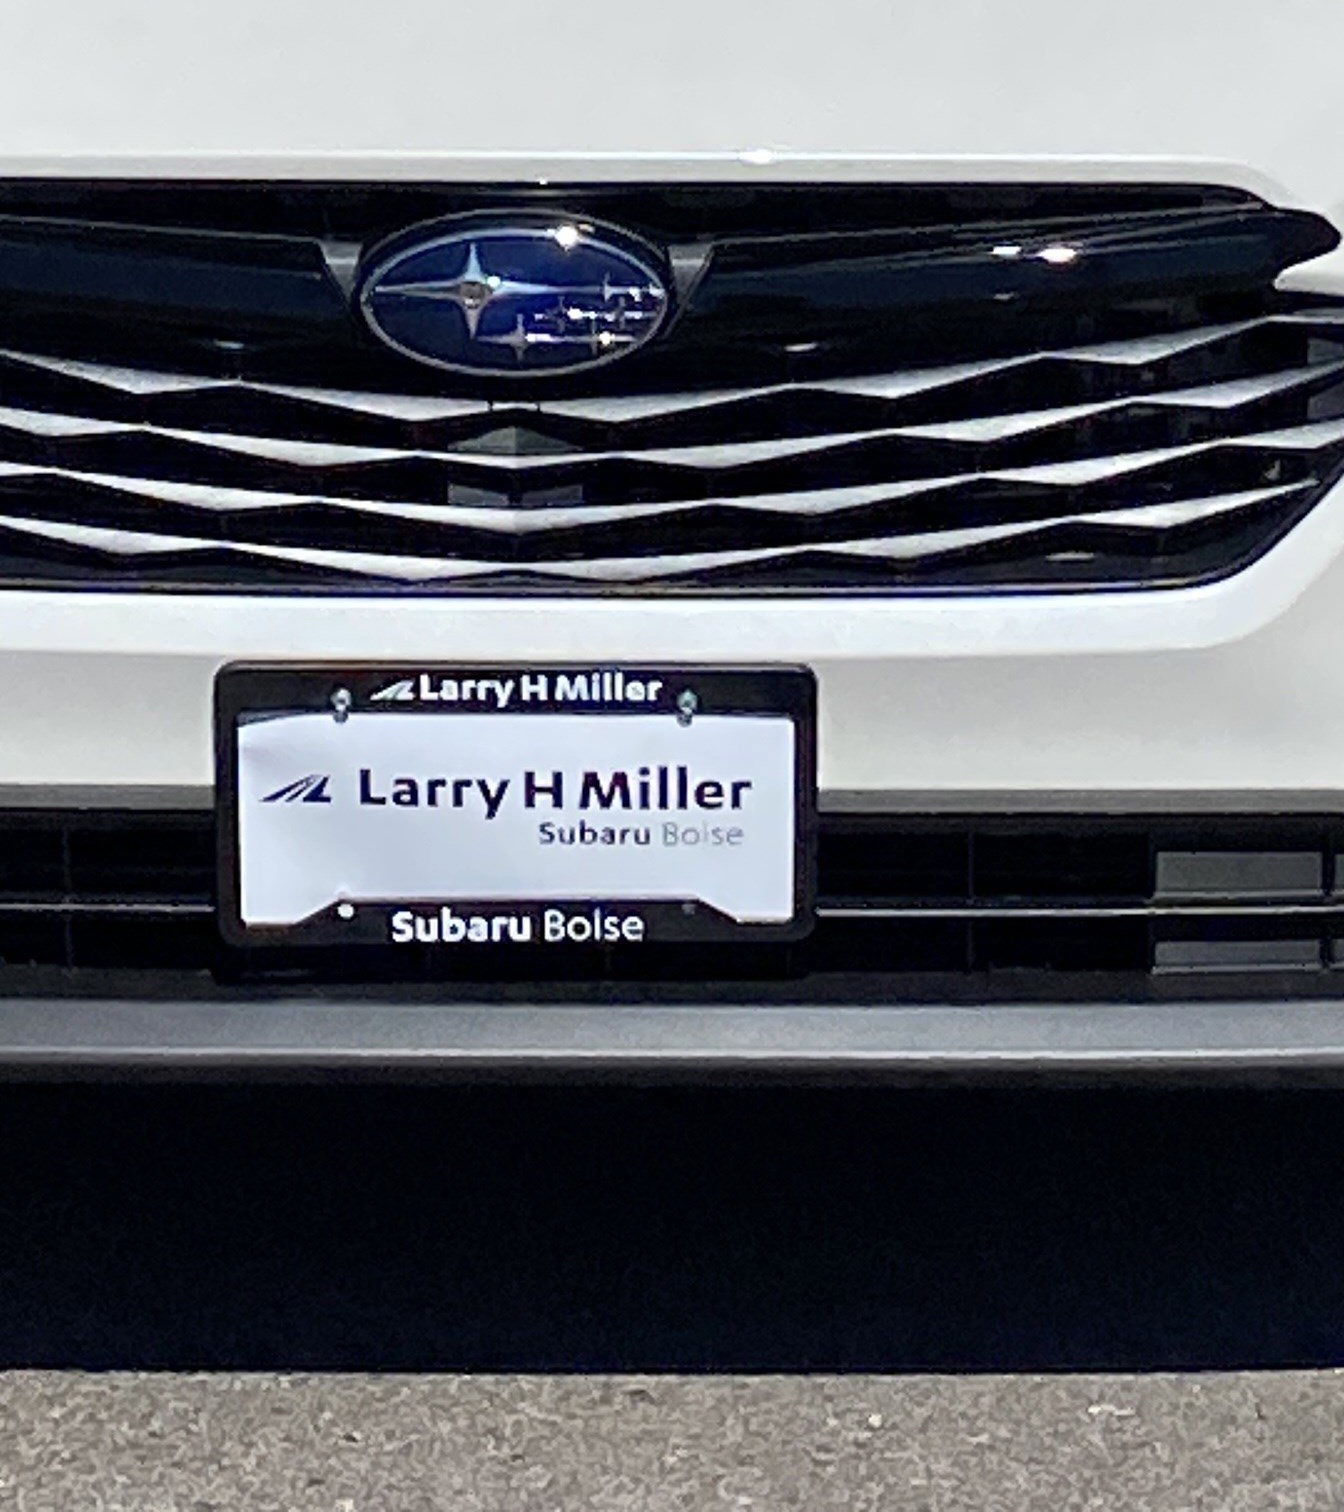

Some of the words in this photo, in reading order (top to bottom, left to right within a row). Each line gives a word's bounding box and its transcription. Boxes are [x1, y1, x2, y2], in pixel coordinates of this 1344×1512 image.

[419, 674, 514, 708] Larry
[521, 674, 548, 701] H
[555, 672, 663, 702] Miller
[359, 768, 510, 820] Larry
[523, 771, 563, 809] H
[578, 765, 752, 810] Miller
[539, 819, 651, 845] Subaru
[662, 821, 744, 847] Boise
[392, 906, 532, 943] Subaru
[544, 906, 644, 942] Boise
